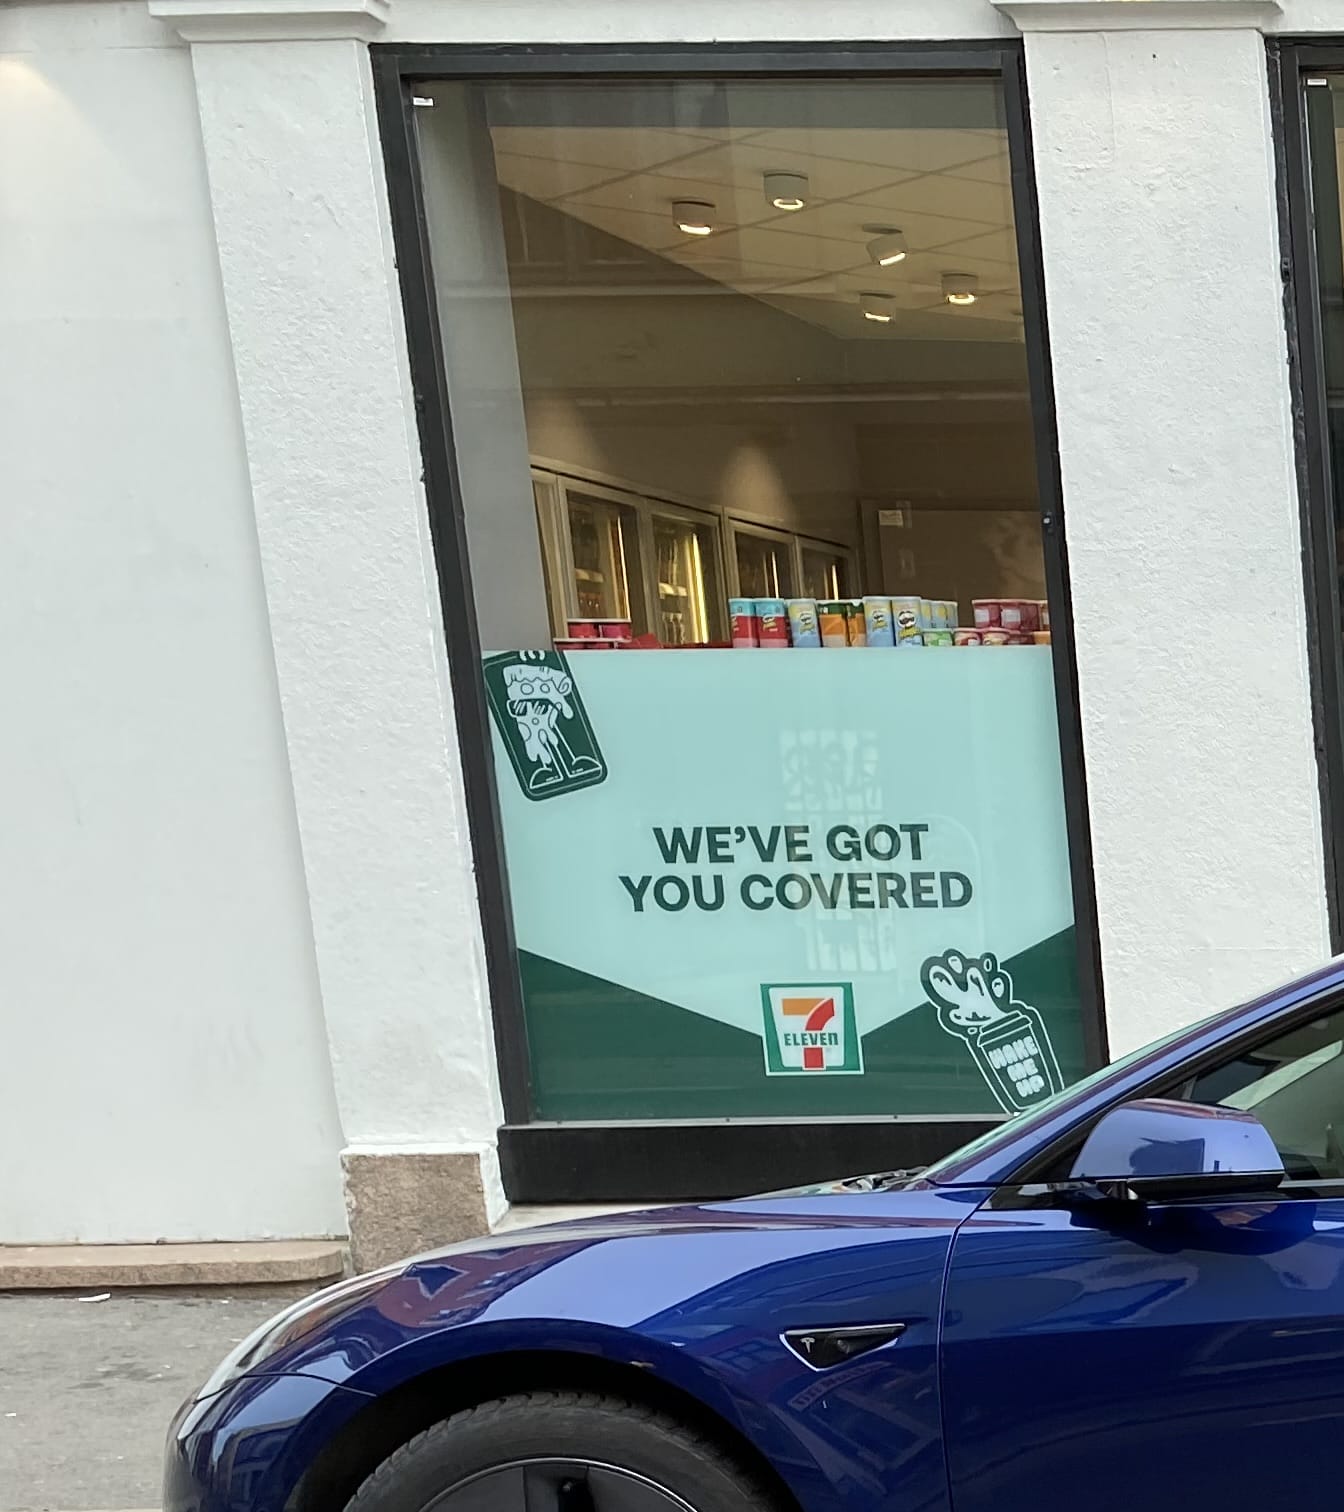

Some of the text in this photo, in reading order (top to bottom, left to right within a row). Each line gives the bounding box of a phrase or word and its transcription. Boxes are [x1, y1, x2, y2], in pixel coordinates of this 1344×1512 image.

[652, 824, 929, 864] WE'VE GOT
[618, 871, 973, 912] YOU COVERED
[782, 998, 835, 1068] 7
